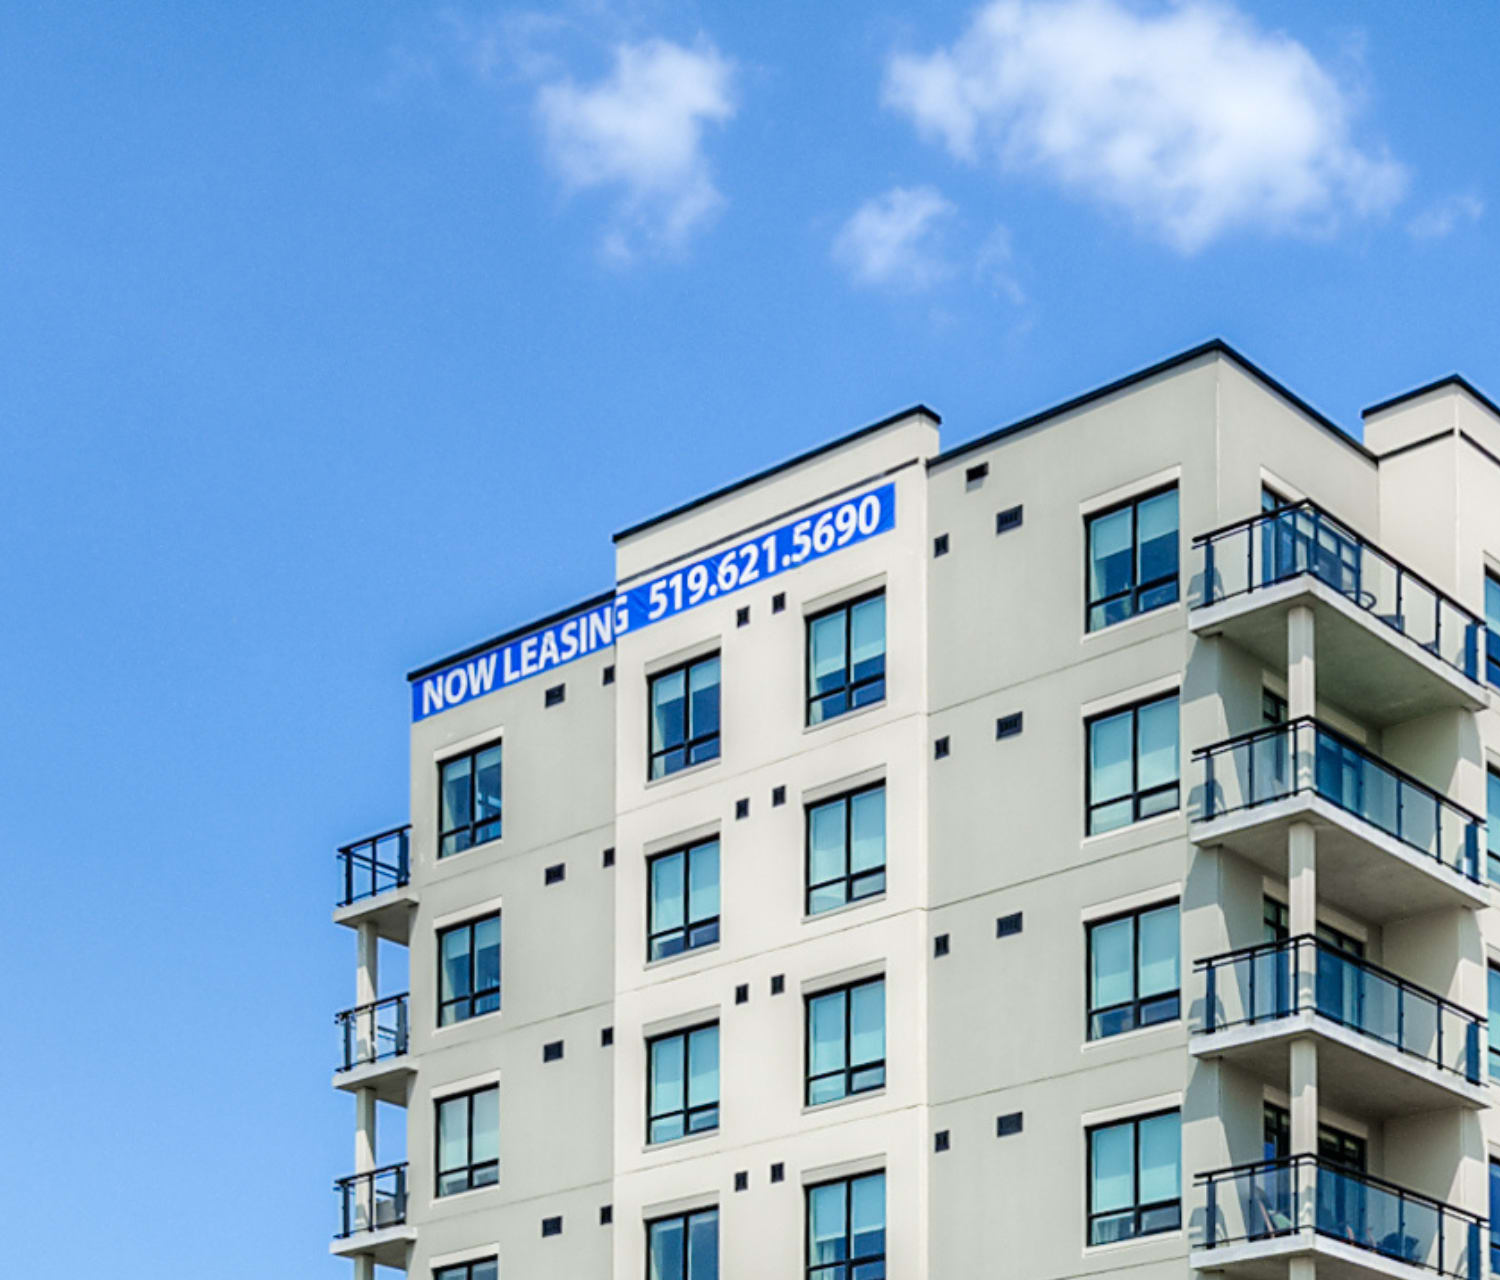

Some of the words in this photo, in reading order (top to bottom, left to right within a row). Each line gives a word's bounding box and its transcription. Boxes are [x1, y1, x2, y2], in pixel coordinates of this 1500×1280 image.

[422, 652, 498, 715] NOW
[503, 595, 629, 684] LEASING
[648, 495, 880, 620] 519.621.5690
